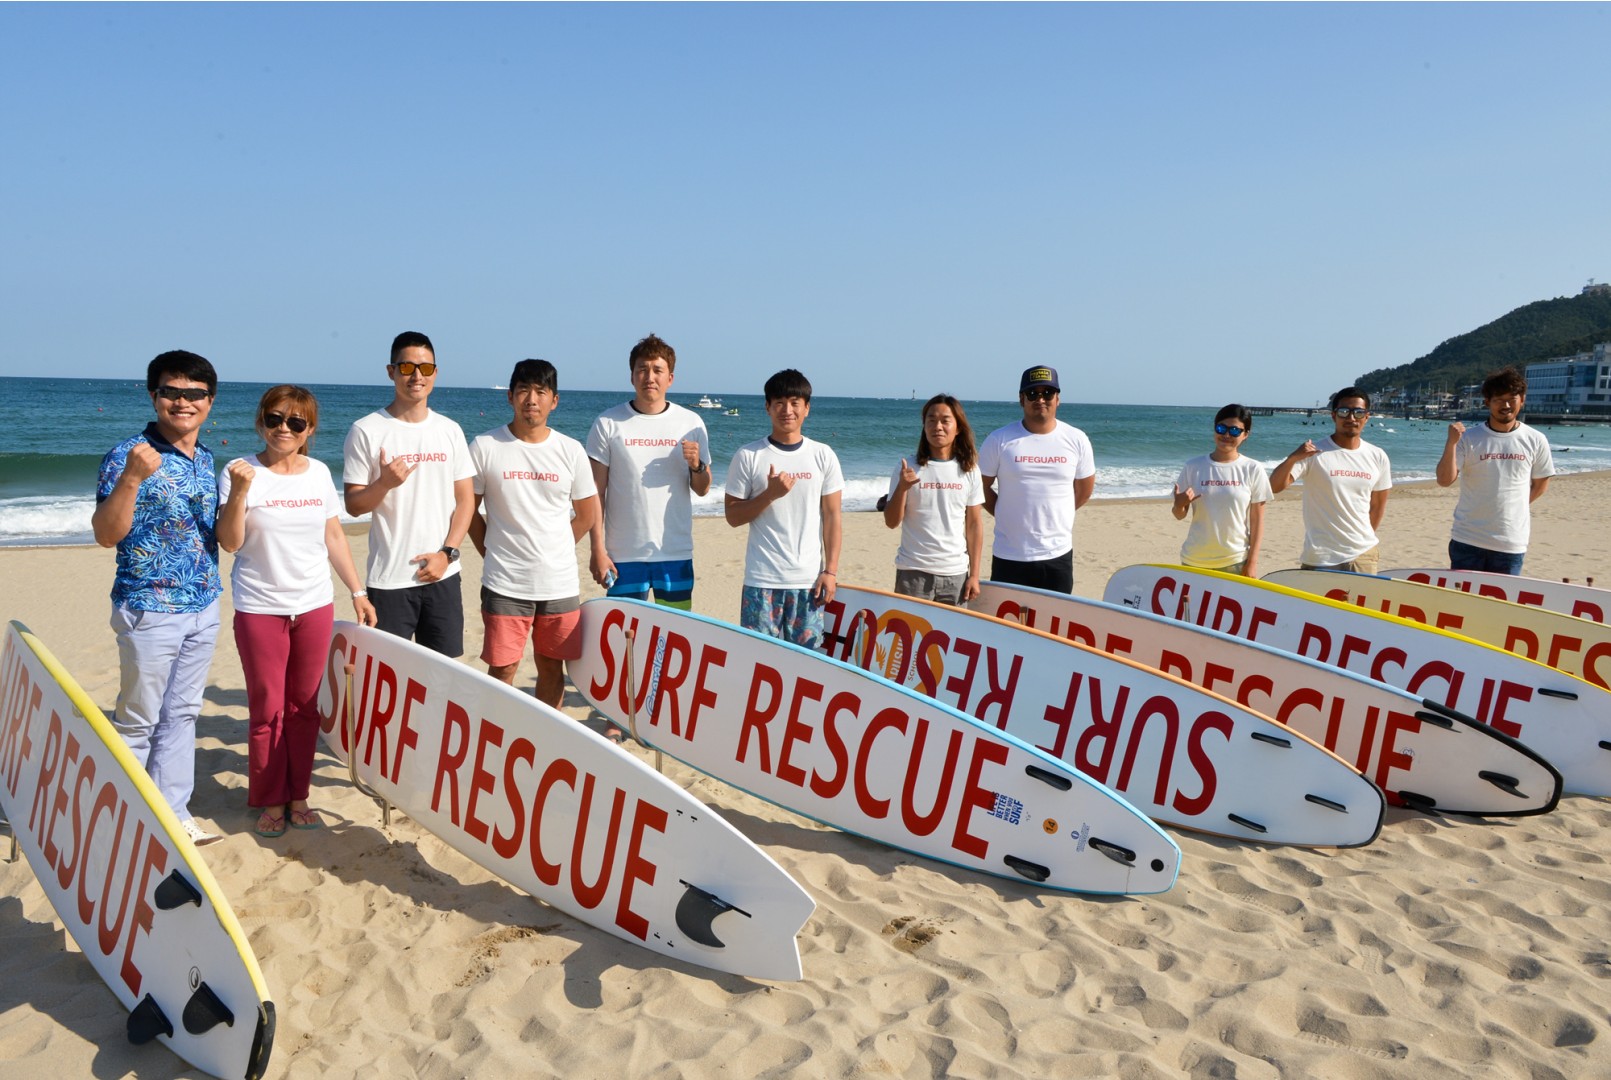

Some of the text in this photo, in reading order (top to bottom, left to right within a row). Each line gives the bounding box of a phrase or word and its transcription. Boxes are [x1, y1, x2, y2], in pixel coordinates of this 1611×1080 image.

[625, 438, 678, 447] LIFEGUARD
[392, 453, 447, 463] FEGUARD
[1014, 456, 1067, 464] LIFEGUARD
[1480, 453, 1526, 461] LIFEGUARD
[503, 471, 559, 483] LIFEGUARD
[1329, 470, 1372, 480] LIFEGUARD
[919, 482, 963, 490] LIFEGUARD
[265, 498, 323, 508] LIFEGUARD
[590, 608, 728, 742] SURF
[735, 662, 1010, 860] RESCUE
[319, 633, 669, 941] SURF RESCUE
[995, 794, 1008, 819] BETTER
[0, 633, 169, 999] URF RESCUE
[1009, 799, 1024, 826] SURF
